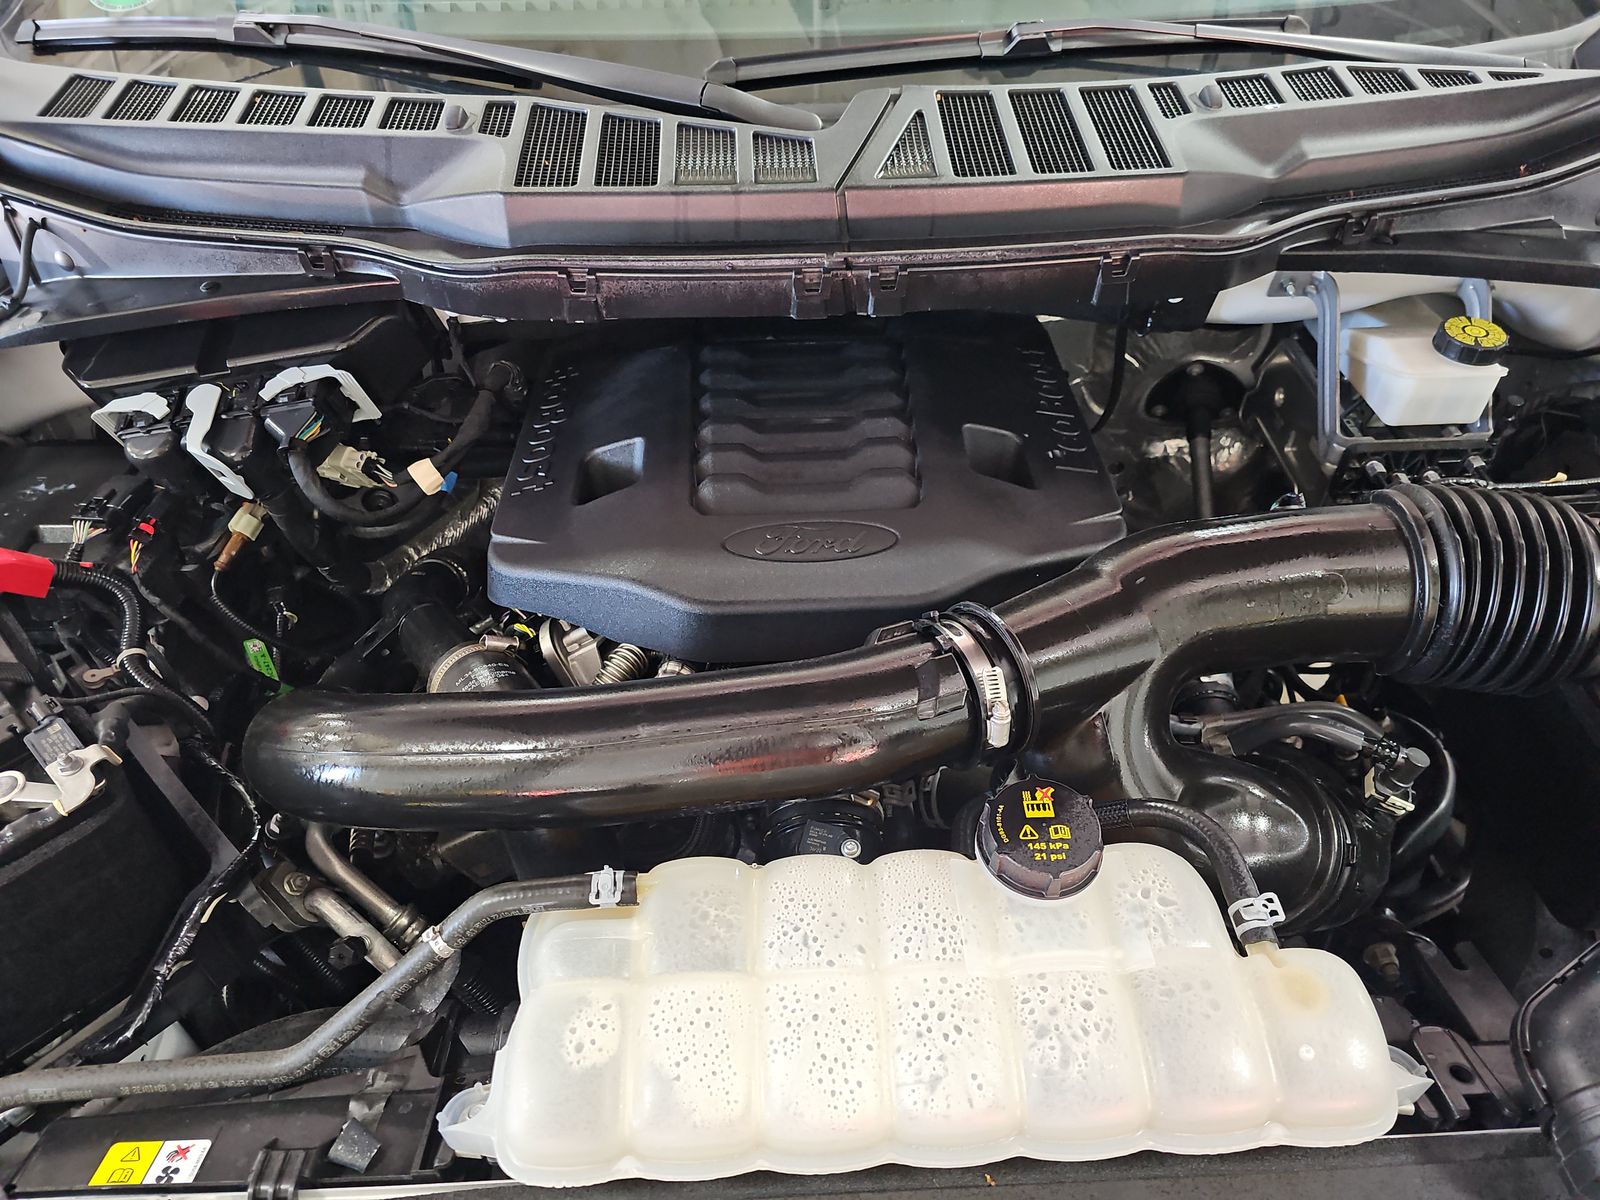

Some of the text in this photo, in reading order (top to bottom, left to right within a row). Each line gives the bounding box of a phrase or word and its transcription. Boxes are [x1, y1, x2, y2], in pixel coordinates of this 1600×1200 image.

[754, 524, 867, 556] Ford
[1027, 842, 1070, 850] 145 kPa
[1034, 852, 1067, 862] 21 psi
